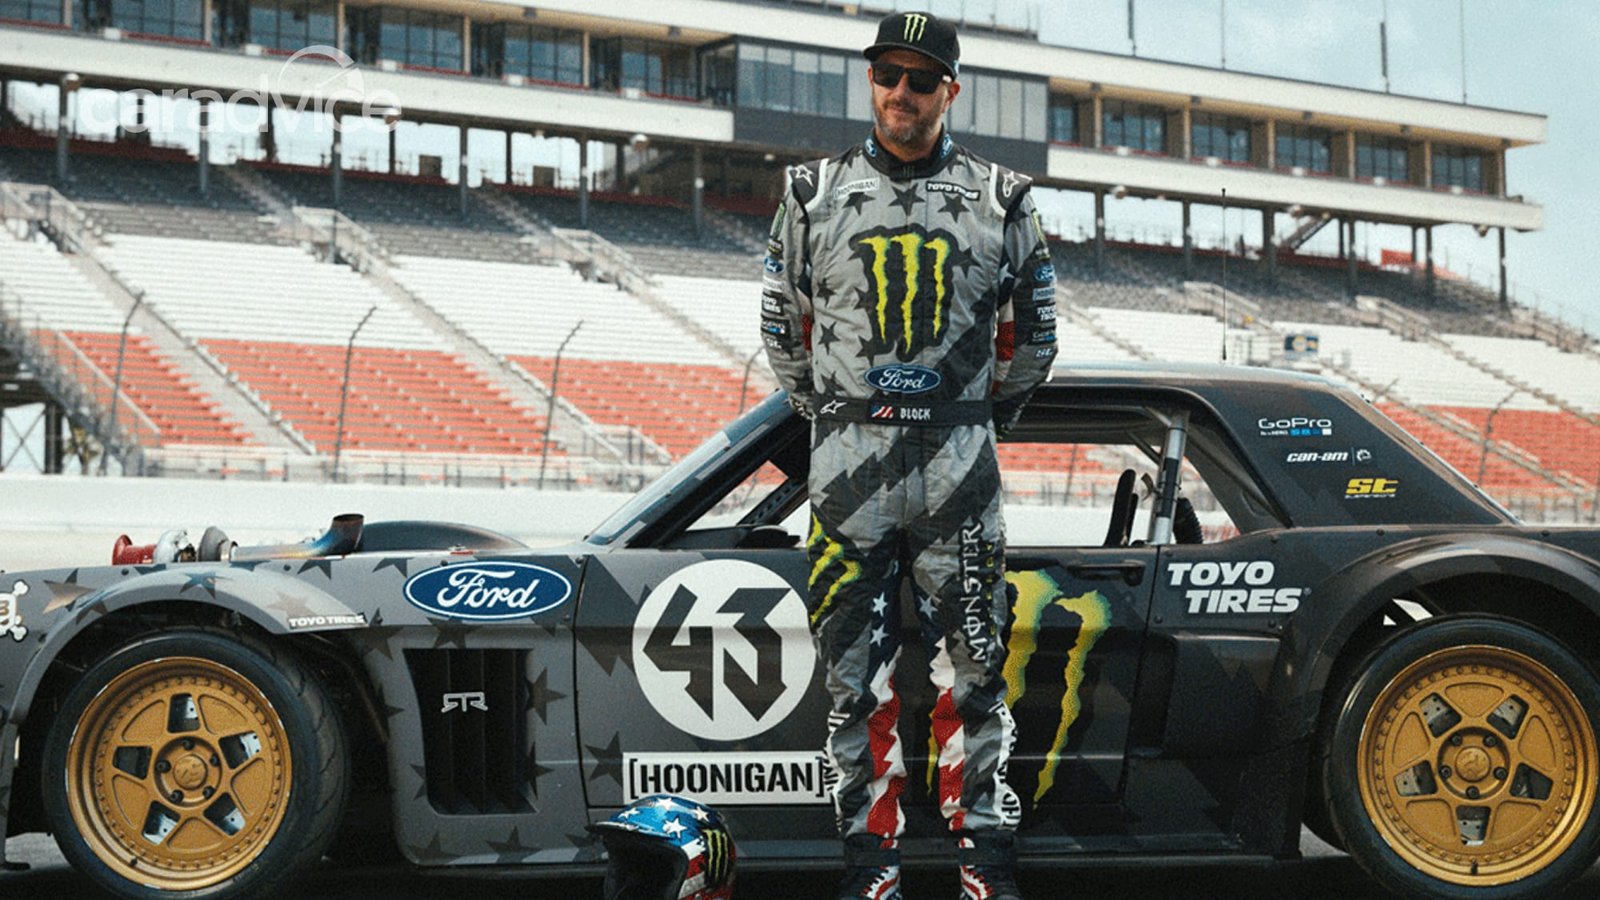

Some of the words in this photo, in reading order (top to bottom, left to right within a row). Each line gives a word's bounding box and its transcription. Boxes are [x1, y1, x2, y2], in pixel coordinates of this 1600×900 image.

[927, 183, 952, 191] TOYO
[879, 368, 926, 389] Ford
[900, 407, 931, 420] BLOCK
[1258, 417, 1332, 429] GoPro
[1287, 452, 1348, 462] can-am
[1167, 561, 1275, 586] TOYO
[437, 569, 540, 608] Ford
[960, 523, 988, 662] MONSTER
[1185, 588, 1302, 613] TIRES
[289, 616, 325, 627] TOYO
[326, 615, 364, 625] TIRES
[643, 583, 791, 722] 43
